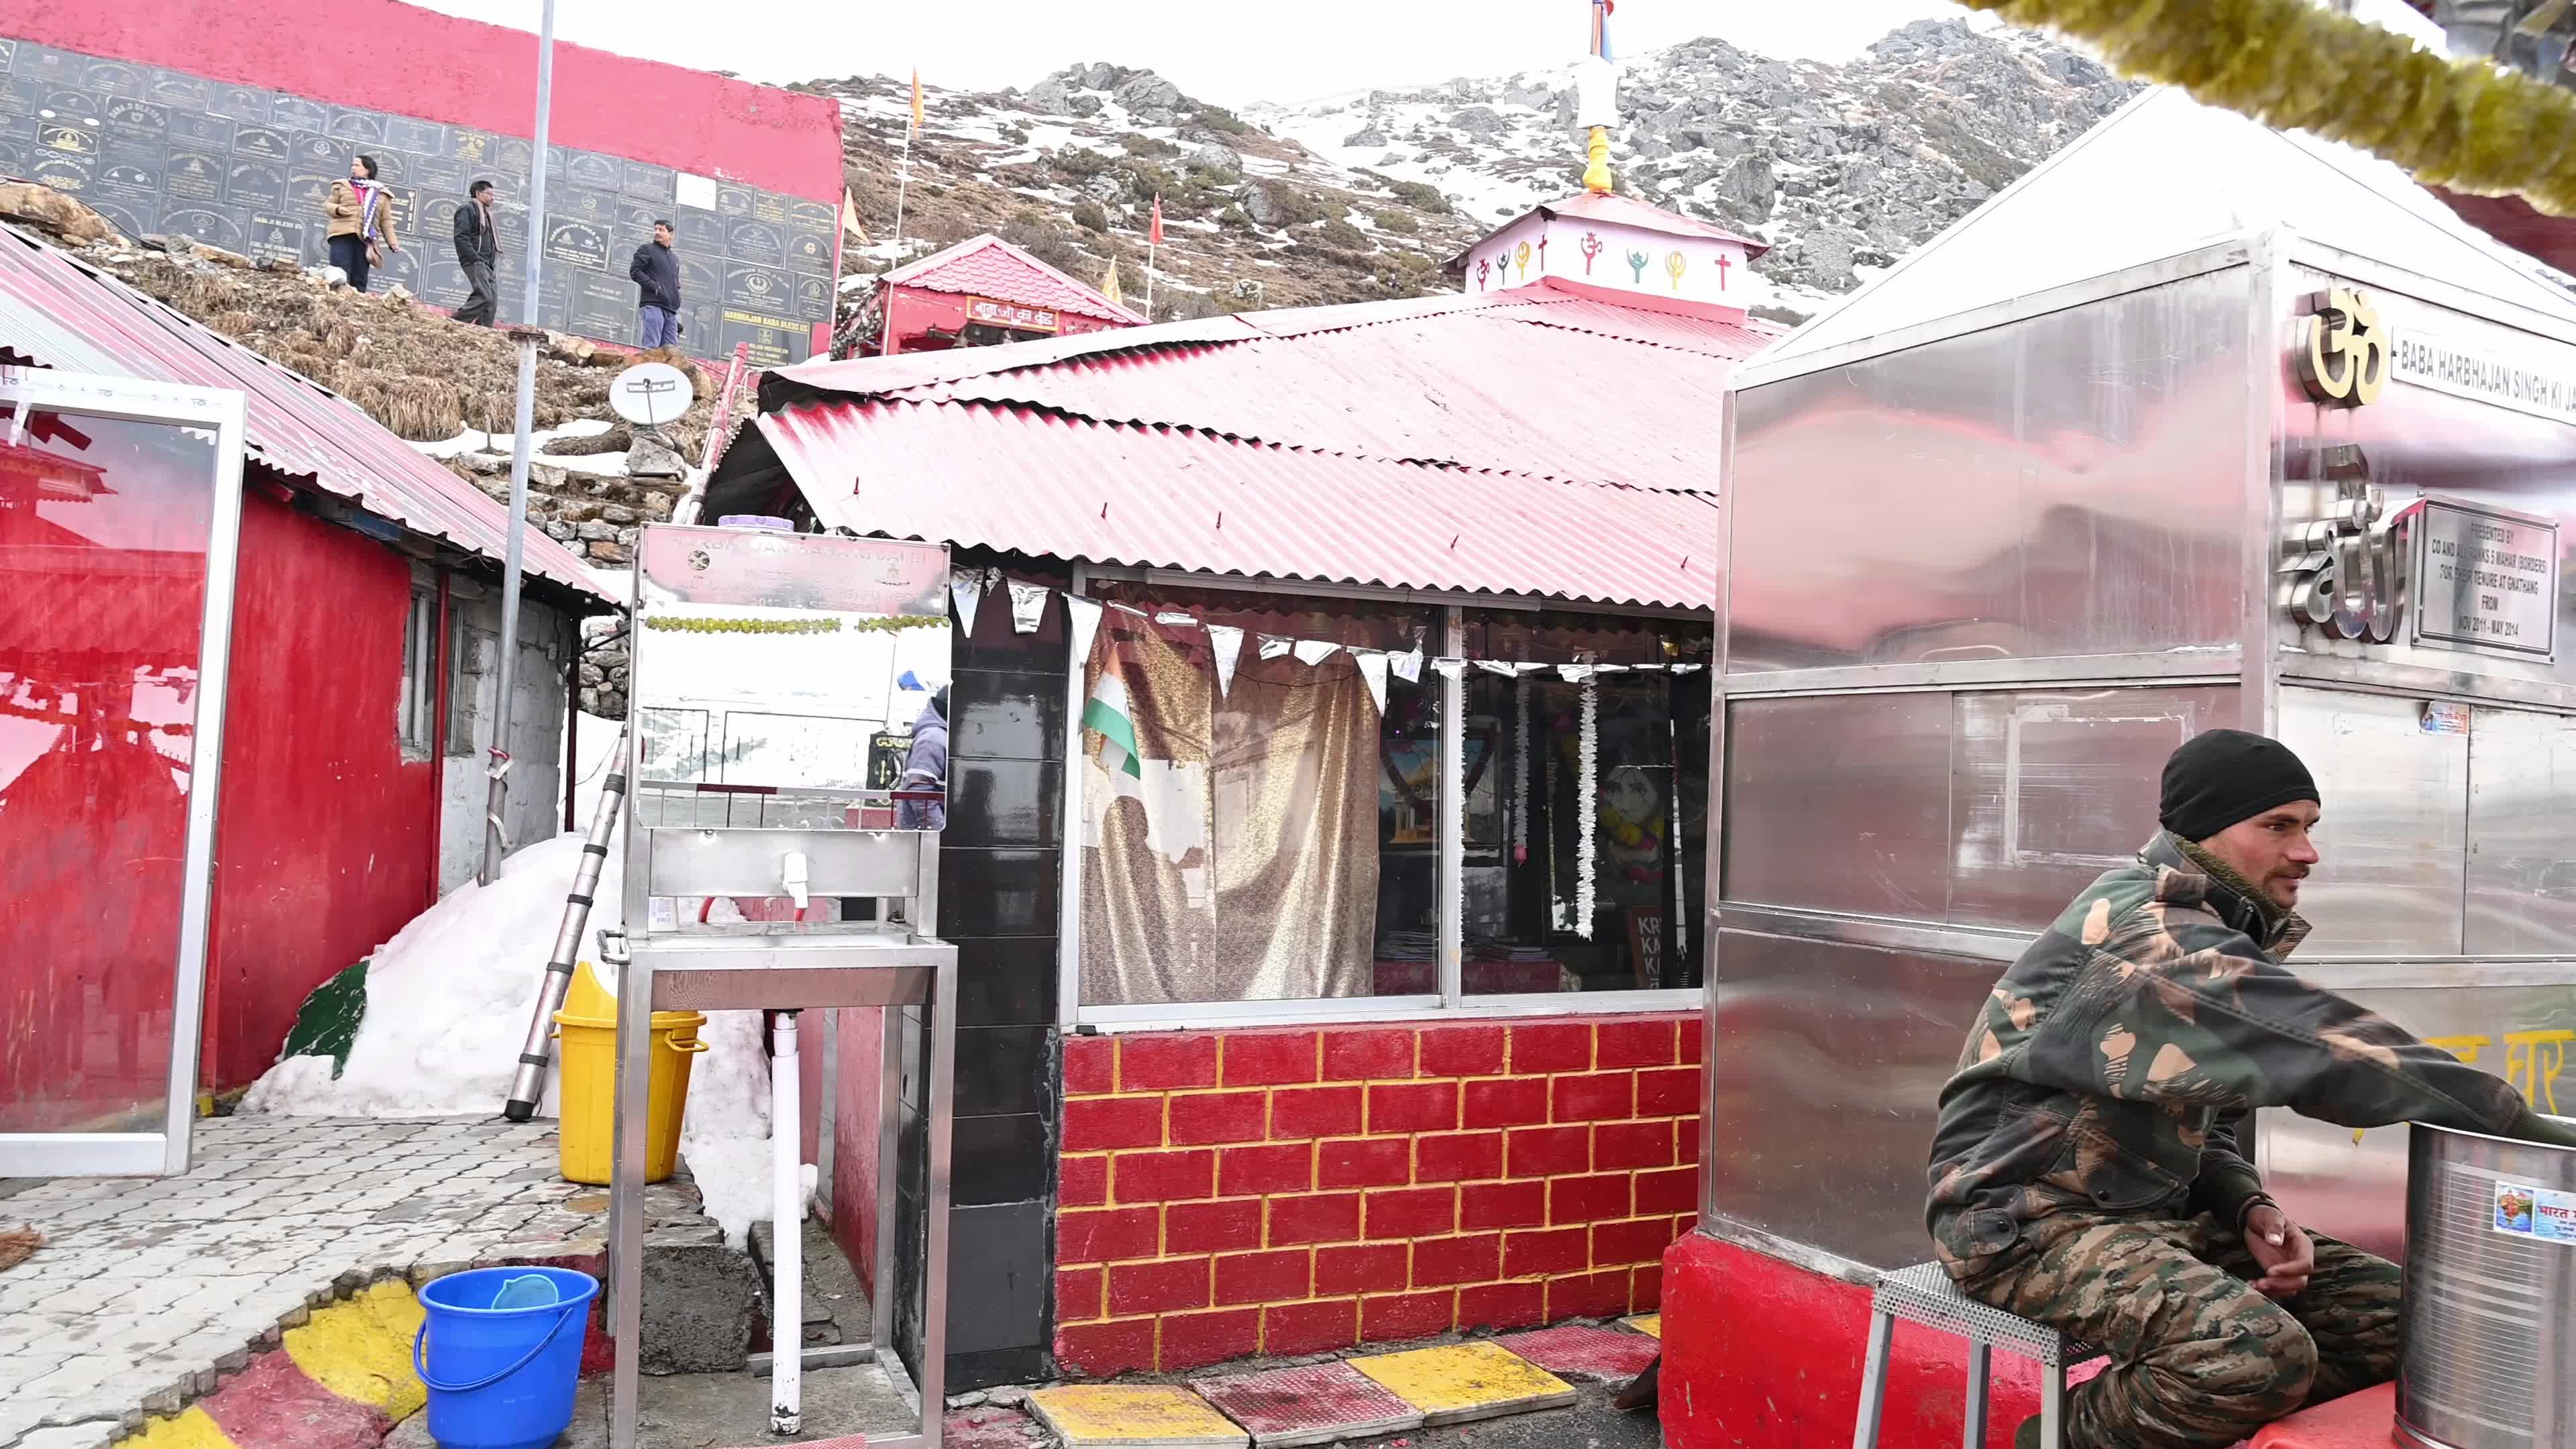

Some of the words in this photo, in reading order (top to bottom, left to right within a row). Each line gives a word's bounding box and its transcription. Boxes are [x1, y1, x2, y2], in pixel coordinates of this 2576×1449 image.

[724, 311, 763, 324] HARBHAJAN
[763, 317, 780, 327] BABA
[781, 320, 799, 331] BLESS
[800, 324, 808, 333] US
[2402, 340, 2433, 377] BABA
[2438, 350, 2510, 396] HARBHAJAN
[2514, 370, 2547, 406] SINGH
[2551, 380, 2562, 409] KI
[2471, 523, 2505, 543] PRESENTED
[2506, 530, 2514, 545] BY
[2432, 539, 2440, 553] CO
[2442, 541, 2455, 557] AND
[2469, 545, 2489, 563] RANKS
[2491, 549, 2495, 564] 5
[2496, 551, 2516, 568] MAHAR
[2440, 564, 2453, 580] FOR
[2474, 570, 2497, 588] TENURE
[2498, 573, 2506, 588] AT
[2508, 576, 2538, 594] GNATHANG
[2481, 594, 2498, 611] FROM
[2458, 614, 2471, 631] NOV
[2473, 616, 2486, 634] 2011
[2491, 620, 2504, 635] MAY
[2505, 622, 2518, 637] 2014
[2538, 1205, 2570, 1219] भारत
